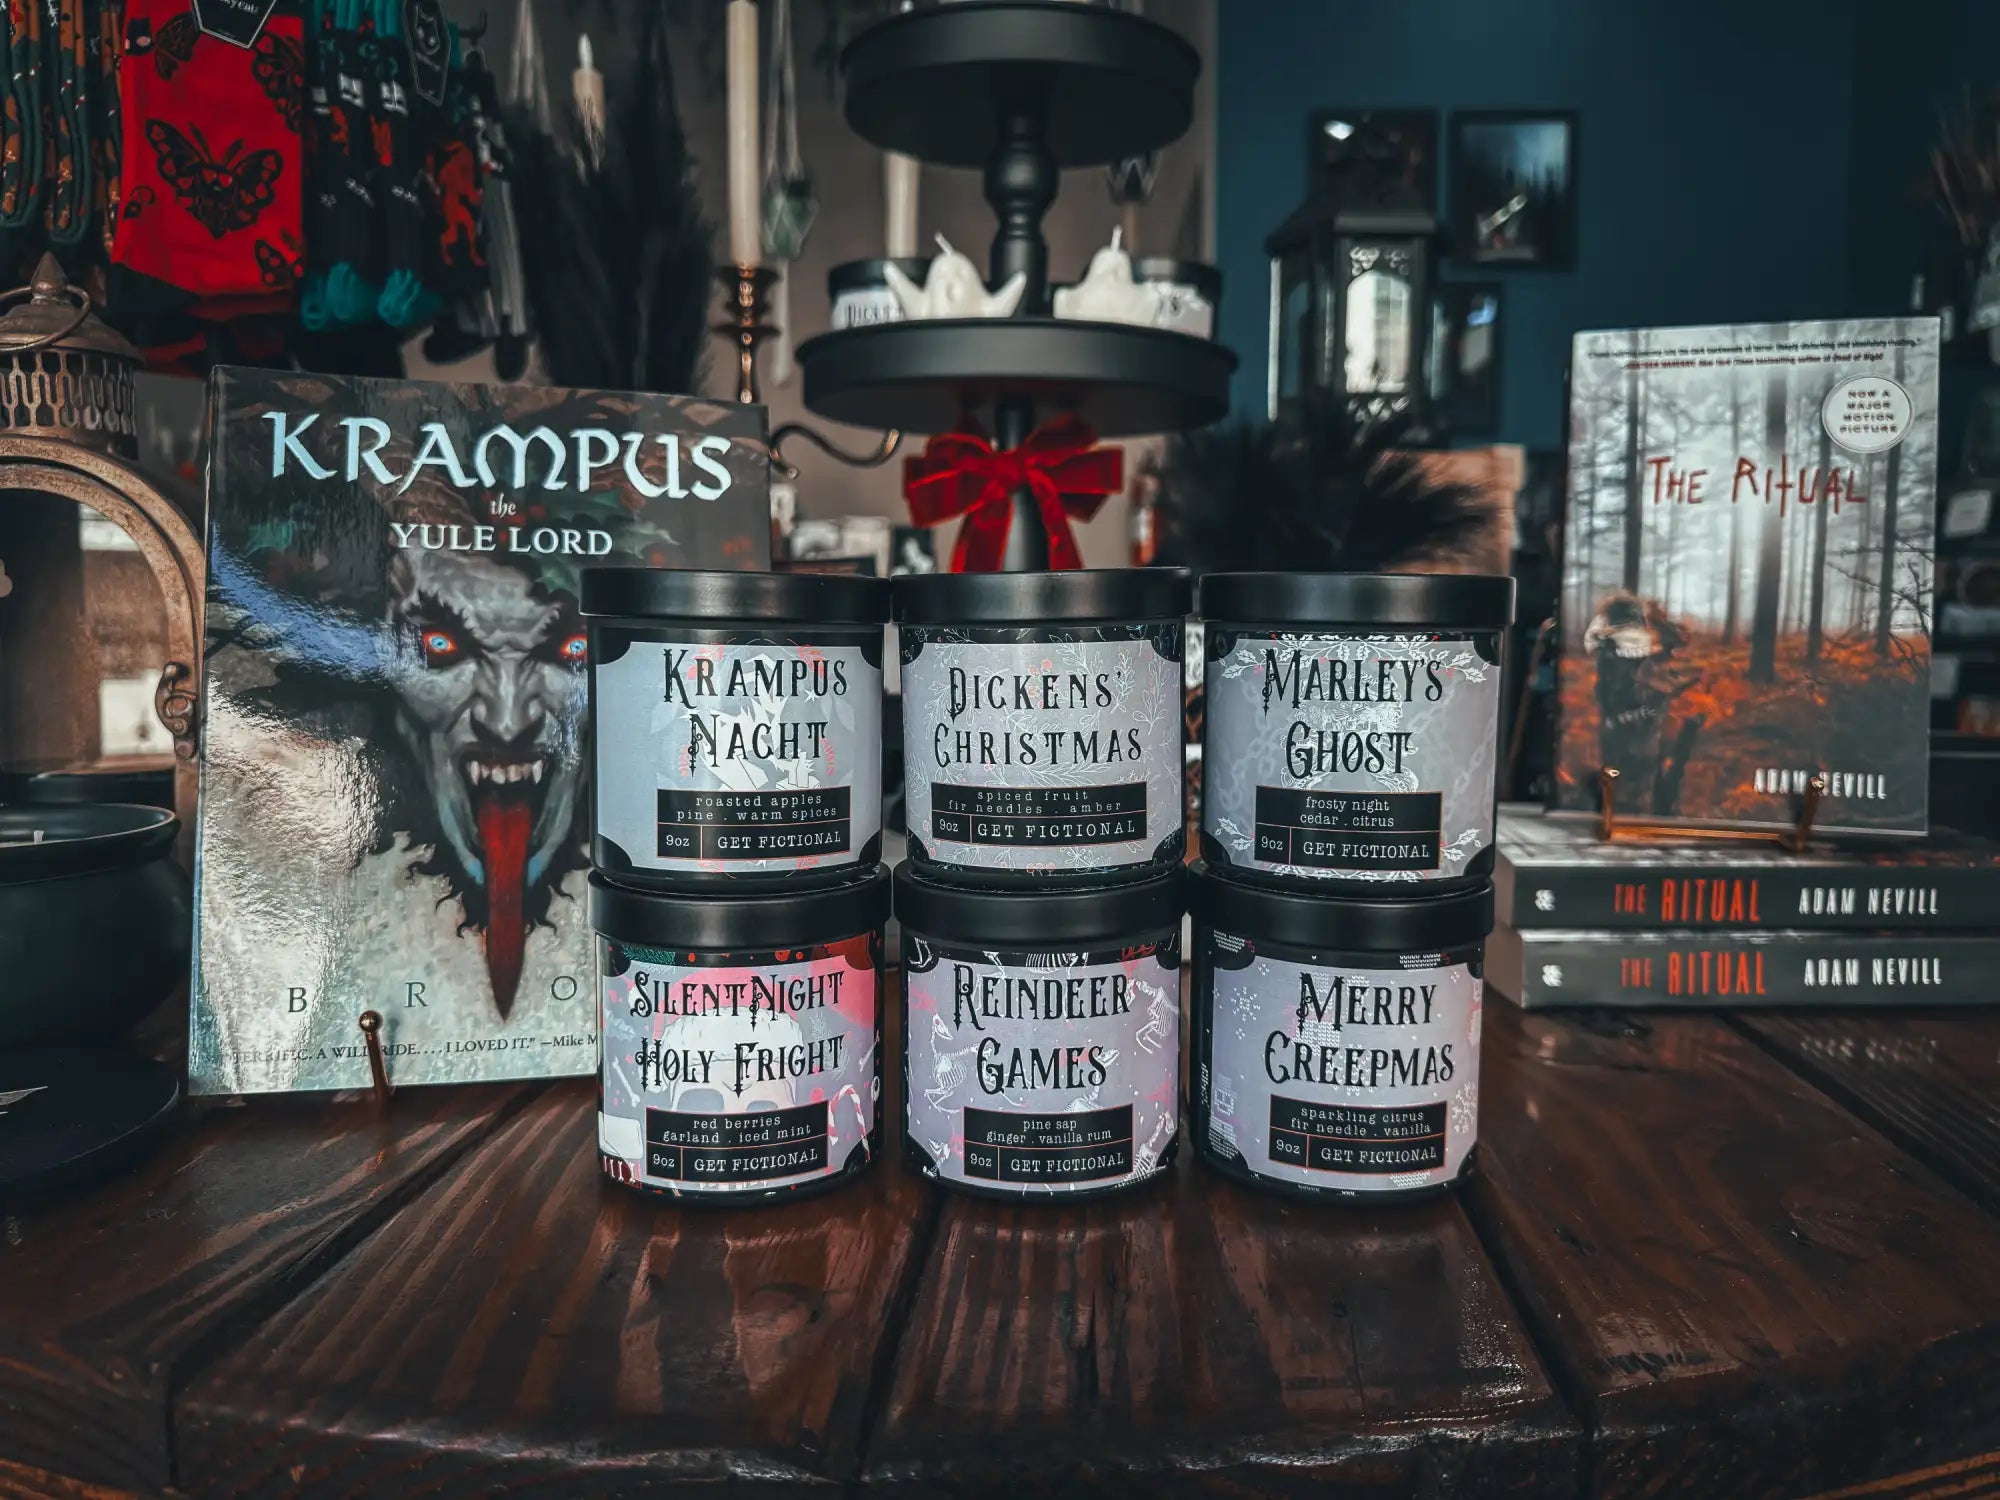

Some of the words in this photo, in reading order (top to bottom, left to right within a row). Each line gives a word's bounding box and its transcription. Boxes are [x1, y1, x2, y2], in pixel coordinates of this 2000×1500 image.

[1848, 389, 1876, 398] NOW
[1882, 389, 1890, 397] A
[1847, 401, 1891, 409] MAJOR
[1843, 413, 1894, 422] MOTION
[1840, 425, 1897, 433] PICTURE
[262, 410, 733, 500] KRAMPUS
[1648, 457, 1708, 505] THE
[490, 492, 517, 518] the
[389, 523, 496, 551] YULE
[509, 526, 613, 555] LORD
[663, 648, 848, 709] KRAMPUS
[1262, 649, 1443, 719] MARLEY'S
[947, 667, 1122, 724] DICKENS'
[688, 713, 829, 777] NACHT
[934, 722, 1143, 768] CHRISTMAS
[1286, 720, 1413, 779] GHOST
[1754, 768, 1808, 795] ADAM
[696, 796, 762, 807] roasted
[771, 794, 822, 808] apples
[977, 791, 1032, 802] spiced
[1045, 791, 1088, 801] fruit
[1305, 796, 1347, 813] frosty
[1352, 799, 1389, 814] night
[677, 809, 714, 822] pine
[737, 810, 783, 821] warm
[792, 808, 837, 820] spices
[948, 799, 966, 811] fir
[976, 802, 1042, 814] needles
[1070, 801, 1121, 813] amber
[939, 818, 959, 832] 9oz
[977, 823, 1014, 838] GET
[1025, 820, 1135, 838] FICTIONAL
[1300, 813, 1338, 825] cedar
[1352, 816, 1394, 827] citrus
[665, 834, 690, 847] 9oz
[717, 836, 751, 849] GET
[758, 831, 841, 848] FICTIONAL
[1261, 836, 1283, 851] 9oz
[1303, 841, 1336, 857] GET
[1341, 844, 1430, 859] FICTIONAL
[1661, 878, 1761, 922] RITUAL
[1799, 887, 1855, 915] ADAM
[1868, 887, 1938, 915] NEVILL
[1668, 951, 1766, 995] RITUAL
[1804, 958, 1859, 986] ADAM
[1872, 957, 1942, 985] NEVILL
[630, 970, 748, 1018] SILENT
[748, 970, 845, 1032] NIGHT
[953, 963, 1130, 1032] REINDEER
[1295, 971, 1437, 1035] MERRY
[316, 1048, 328, 1059] A
[456, 1039, 508, 1053] LOVED
[634, 1036, 716, 1092] HOLY
[734, 1034, 846, 1098] FRIGHT
[976, 1036, 1107, 1095] GAMES
[1264, 1030, 1454, 1087] CREEPMAS
[693, 1118, 717, 1129] red
[725, 1116, 781, 1129] berries
[1301, 1107, 1376, 1125] sparkling
[1382, 1111, 1424, 1123] citrus
[663, 1130, 720, 1144] garland
[739, 1130, 769, 1143] iced
[777, 1124, 811, 1139] mint
[1023, 1119, 1051, 1132] pine
[1056, 1119, 1077, 1131] sap
[1290, 1118, 1309, 1131] fir
[1316, 1123, 1367, 1136] needle
[1384, 1122, 1431, 1137] vanilla
[986, 1130, 1026, 1144] ginger
[1039, 1131, 1083, 1145] vanilla
[1087, 1129, 1112, 1142] rum
[1276, 1139, 1300, 1155] 9oz
[1321, 1147, 1353, 1163] GET
[1358, 1146, 1437, 1163] FICTIONAL
[652, 1153, 675, 1168] 9oz
[694, 1158, 726, 1172] GET
[732, 1148, 818, 1172] FICTIONAL
[970, 1152, 992, 1167] 9oz
[1010, 1158, 1041, 1172] GET
[1046, 1152, 1124, 1172] FICTIONAL
